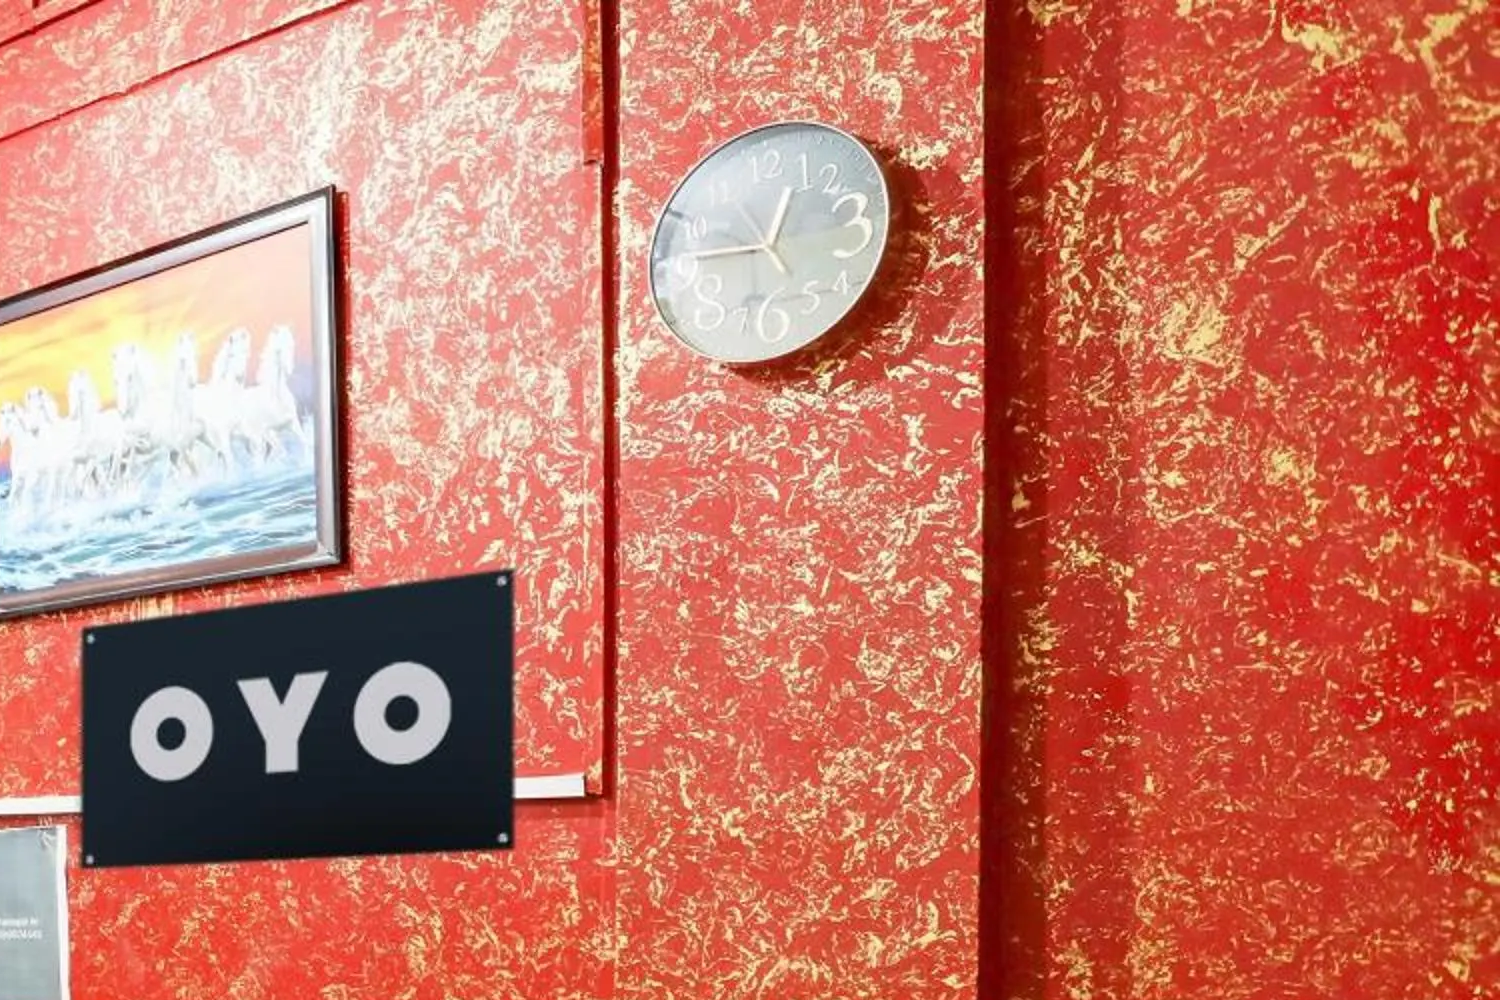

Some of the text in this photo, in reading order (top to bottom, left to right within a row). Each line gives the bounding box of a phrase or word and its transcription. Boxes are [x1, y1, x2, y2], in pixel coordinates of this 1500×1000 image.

[750, 148, 783, 184] 12
[796, 152, 814, 193] 1
[819, 163, 841, 194] 2
[831, 191, 873, 259] 3
[693, 273, 725, 331] 8
[756, 287, 790, 344] 6
[802, 280, 821, 315] 5
[732, 306, 749, 333] 7
[129, 660, 453, 782] OYO
